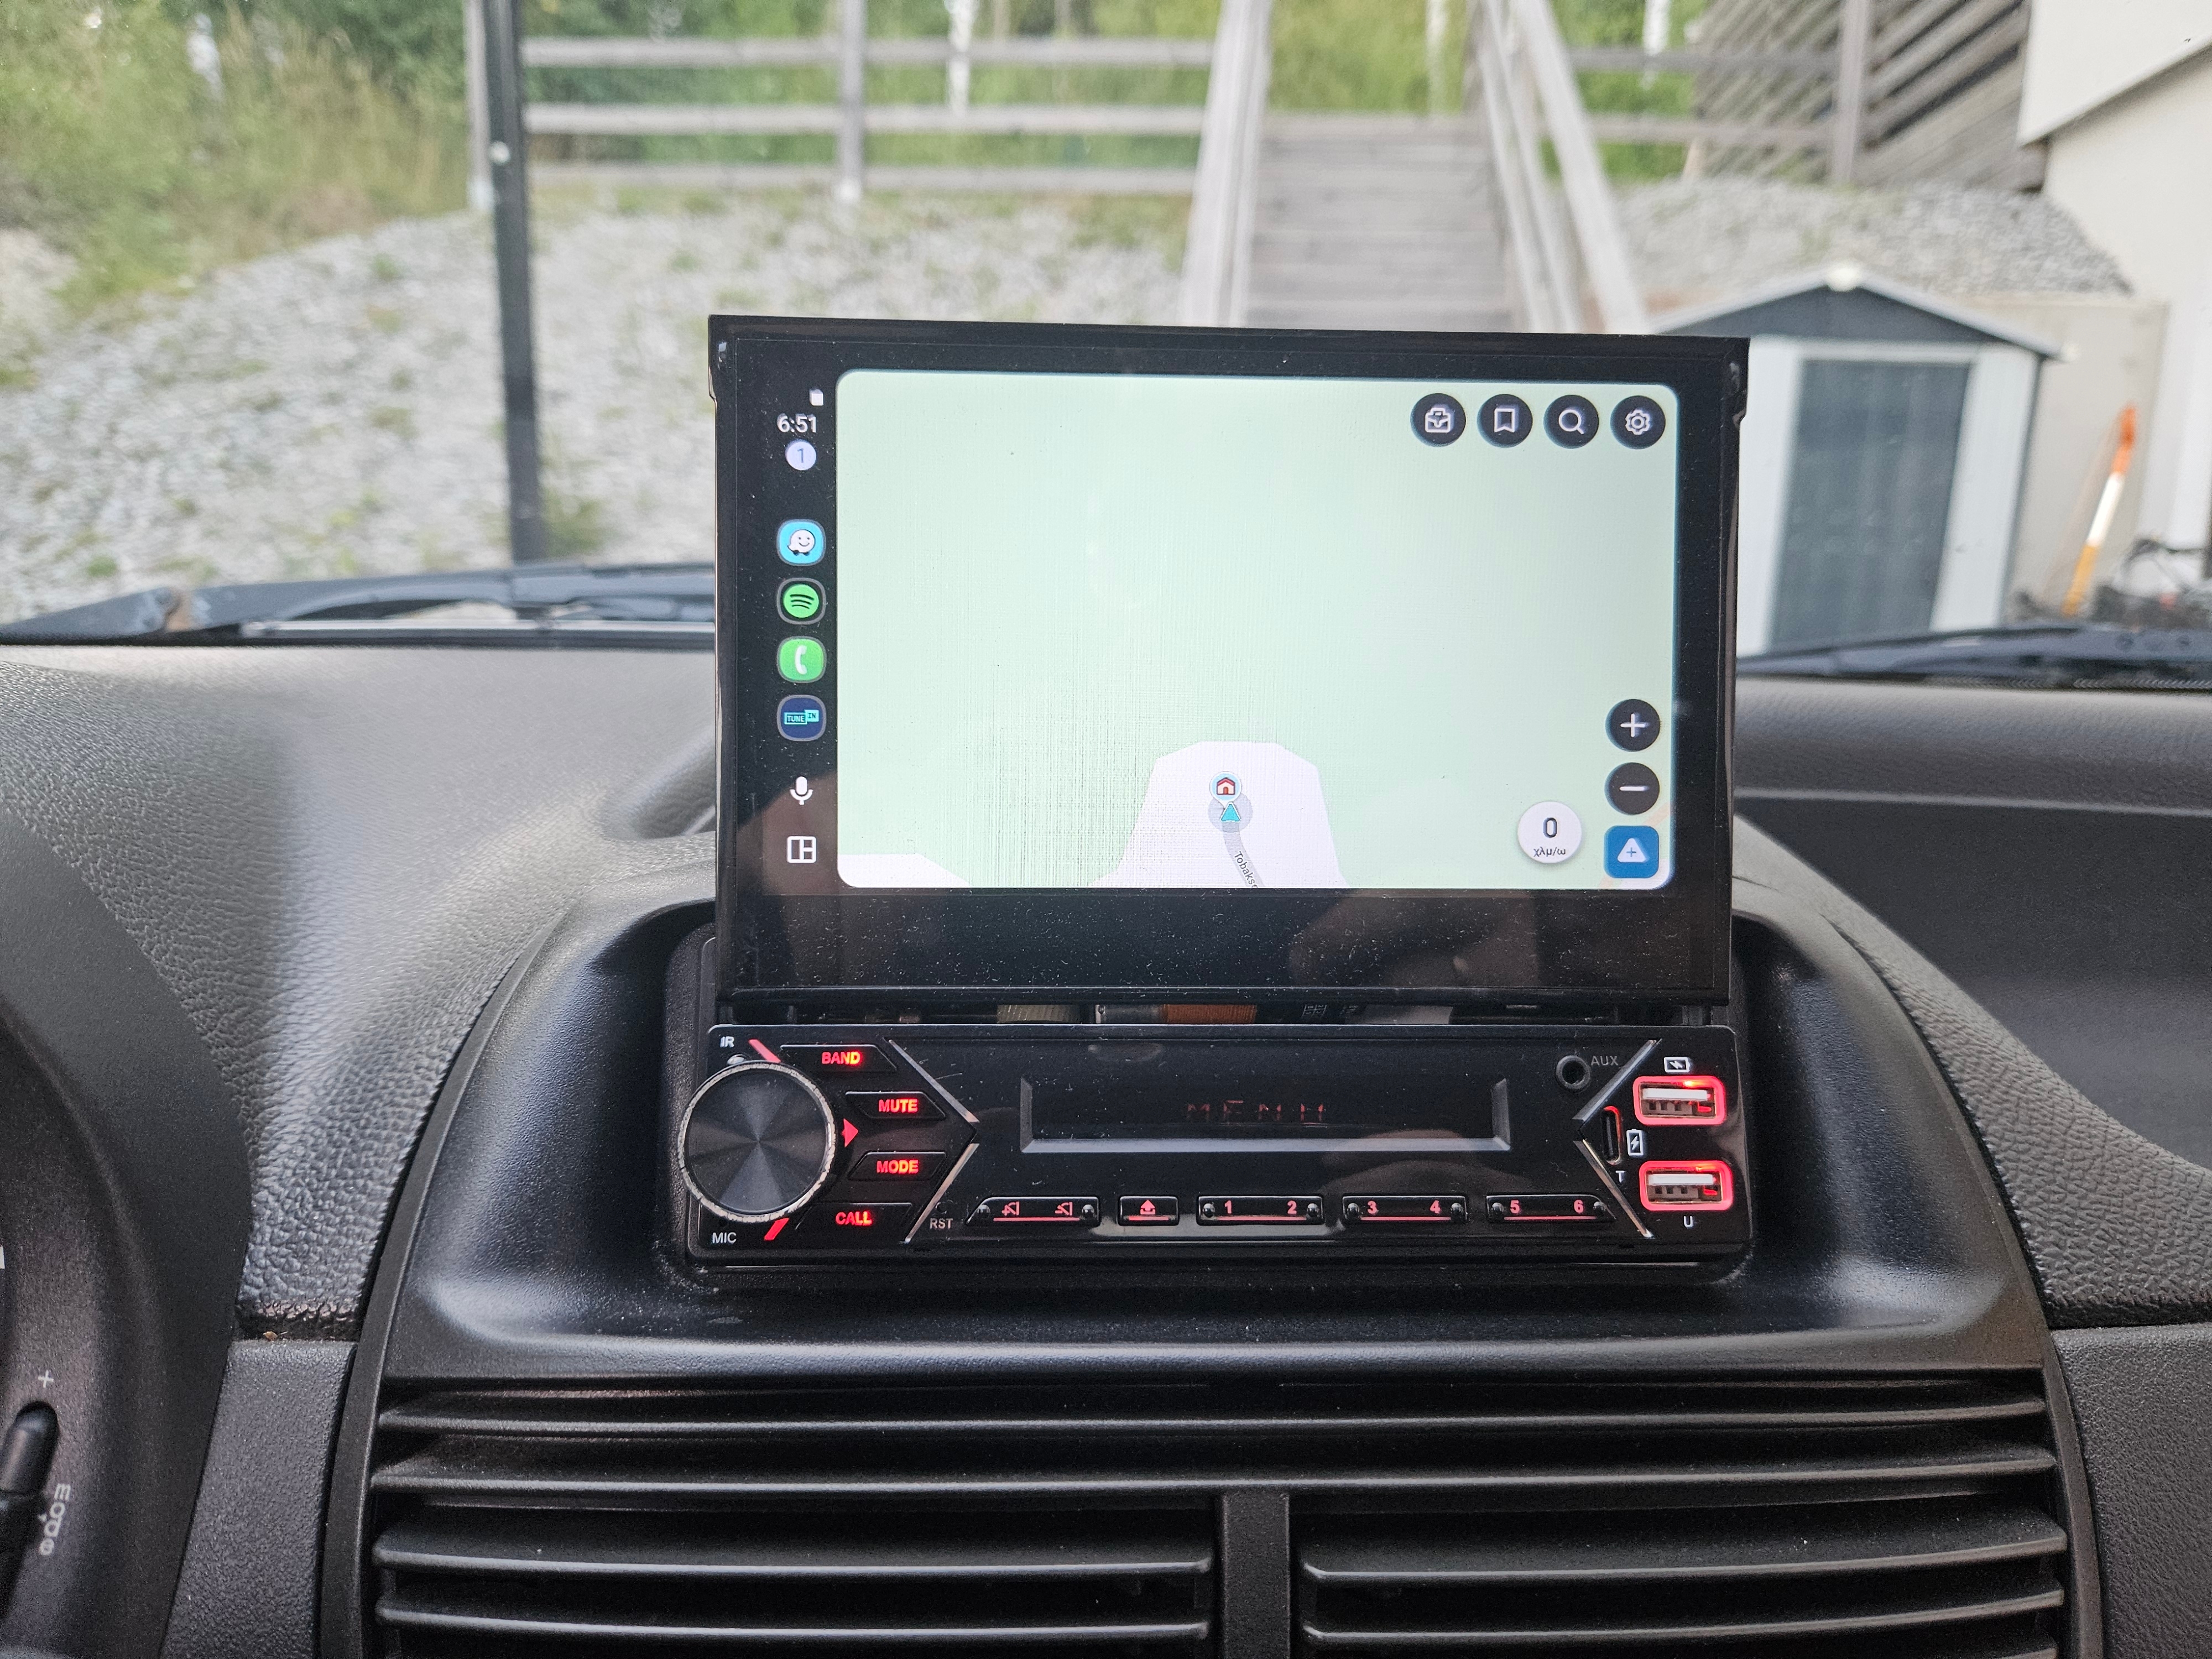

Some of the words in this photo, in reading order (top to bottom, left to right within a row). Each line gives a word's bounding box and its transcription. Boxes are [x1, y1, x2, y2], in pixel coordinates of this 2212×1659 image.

[777, 414, 816, 432] 6:51
[797, 448, 804, 463] 1
[1543, 817, 1558, 838] 0
[720, 1036, 734, 1047] IR
[822, 1052, 863, 1065] BAND
[1590, 1056, 1619, 1066] AUX
[878, 1099, 918, 1113] MUTE
[877, 1160, 919, 1173] MODE
[1615, 1171, 1625, 1182] T
[1224, 1201, 1232, 1214] 1
[1287, 1201, 1297, 1214] 2
[1368, 1201, 1377, 1214] 3
[1430, 1201, 1441, 1214] 4
[1511, 1201, 1520, 1214] 5
[1574, 1200, 1583, 1213] 6
[836, 1212, 872, 1226] CALL
[930, 1218, 953, 1229] RST
[1683, 1216, 1693, 1228] U
[712, 1232, 737, 1243] MIC
